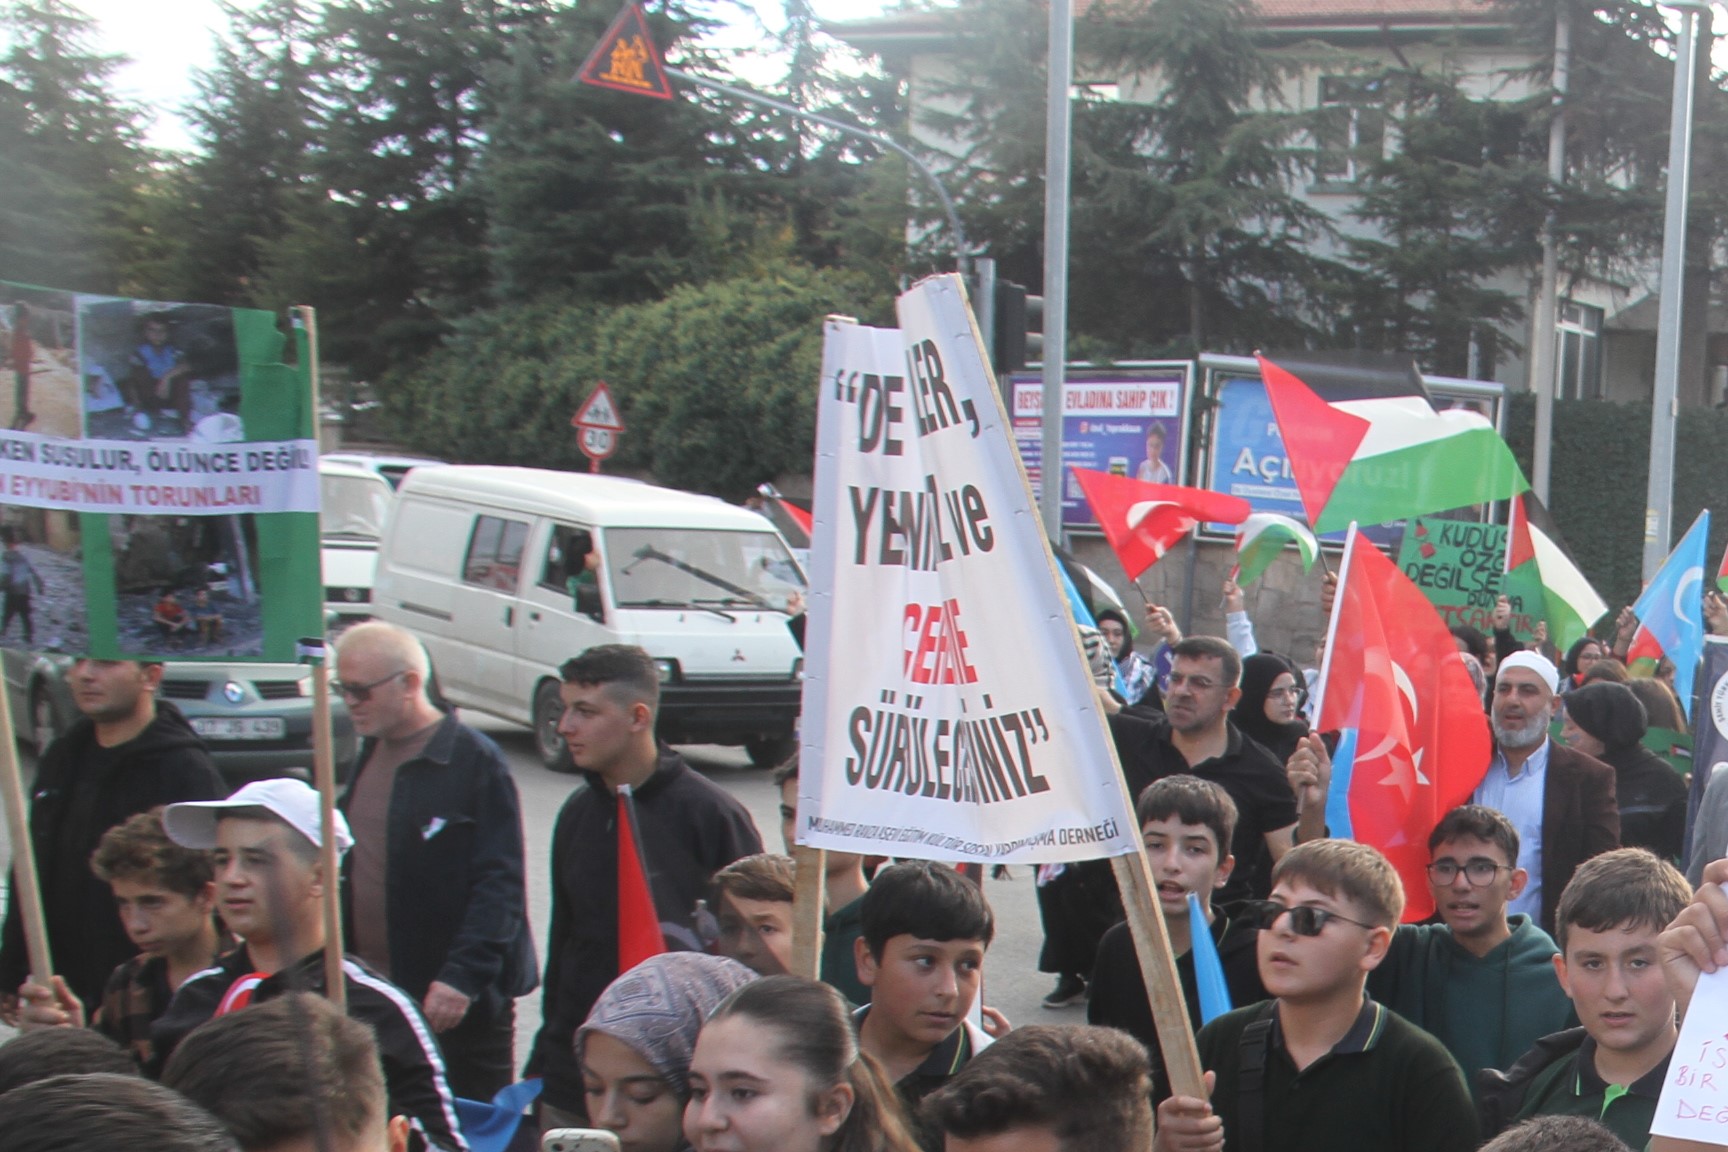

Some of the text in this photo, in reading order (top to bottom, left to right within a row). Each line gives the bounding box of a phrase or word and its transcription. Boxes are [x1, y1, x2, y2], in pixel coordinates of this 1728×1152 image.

[1066, 390, 1113, 410] EVLADINA
[1116, 385, 1147, 410] SAHİP
[586, 429, 609, 449] 30
[40, 440, 141, 475] SUSULUR,
[149, 446, 239, 473] ÖLÜNCE
[130, 484, 263, 507] TORUNLARI
[1059, 817, 1120, 846] DERNEĞİ
[1674, 1065, 1719, 1092] BİR
